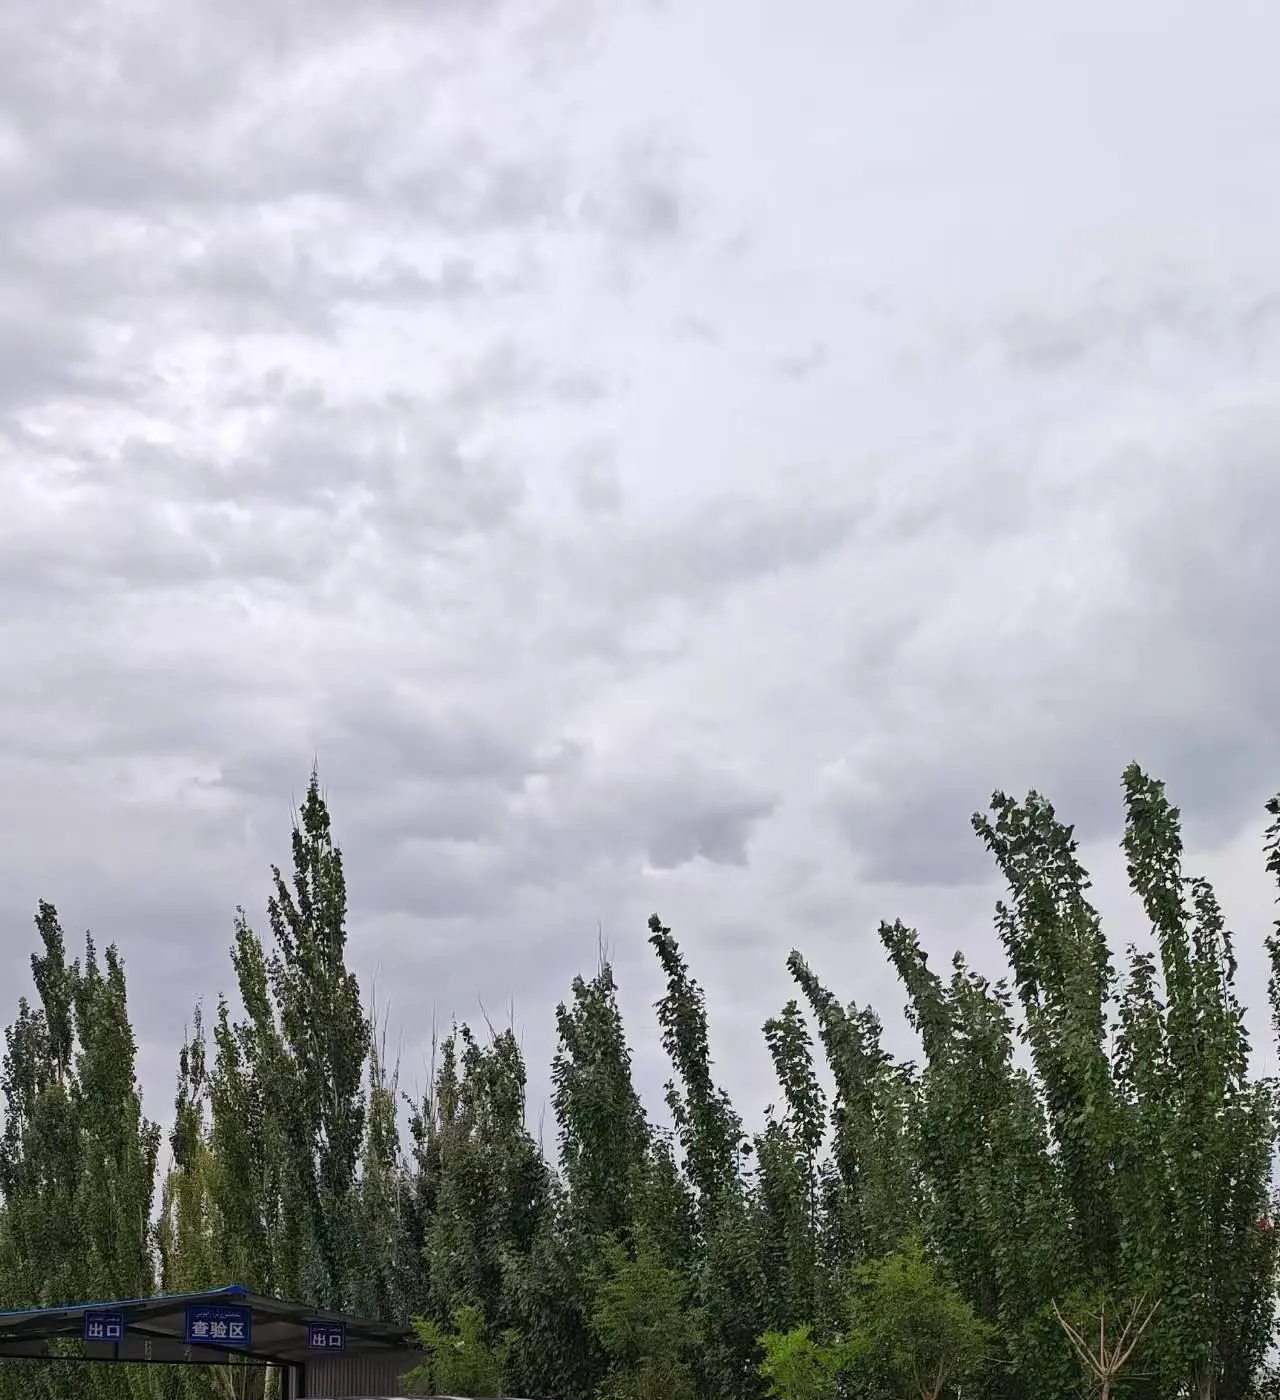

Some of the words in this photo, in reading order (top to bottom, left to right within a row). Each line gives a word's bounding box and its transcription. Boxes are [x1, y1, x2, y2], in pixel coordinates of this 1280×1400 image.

[88, 1322, 120, 1338] 出口
[192, 1320, 245, 1339] 查验区
[313, 1333, 341, 1347] 出口
